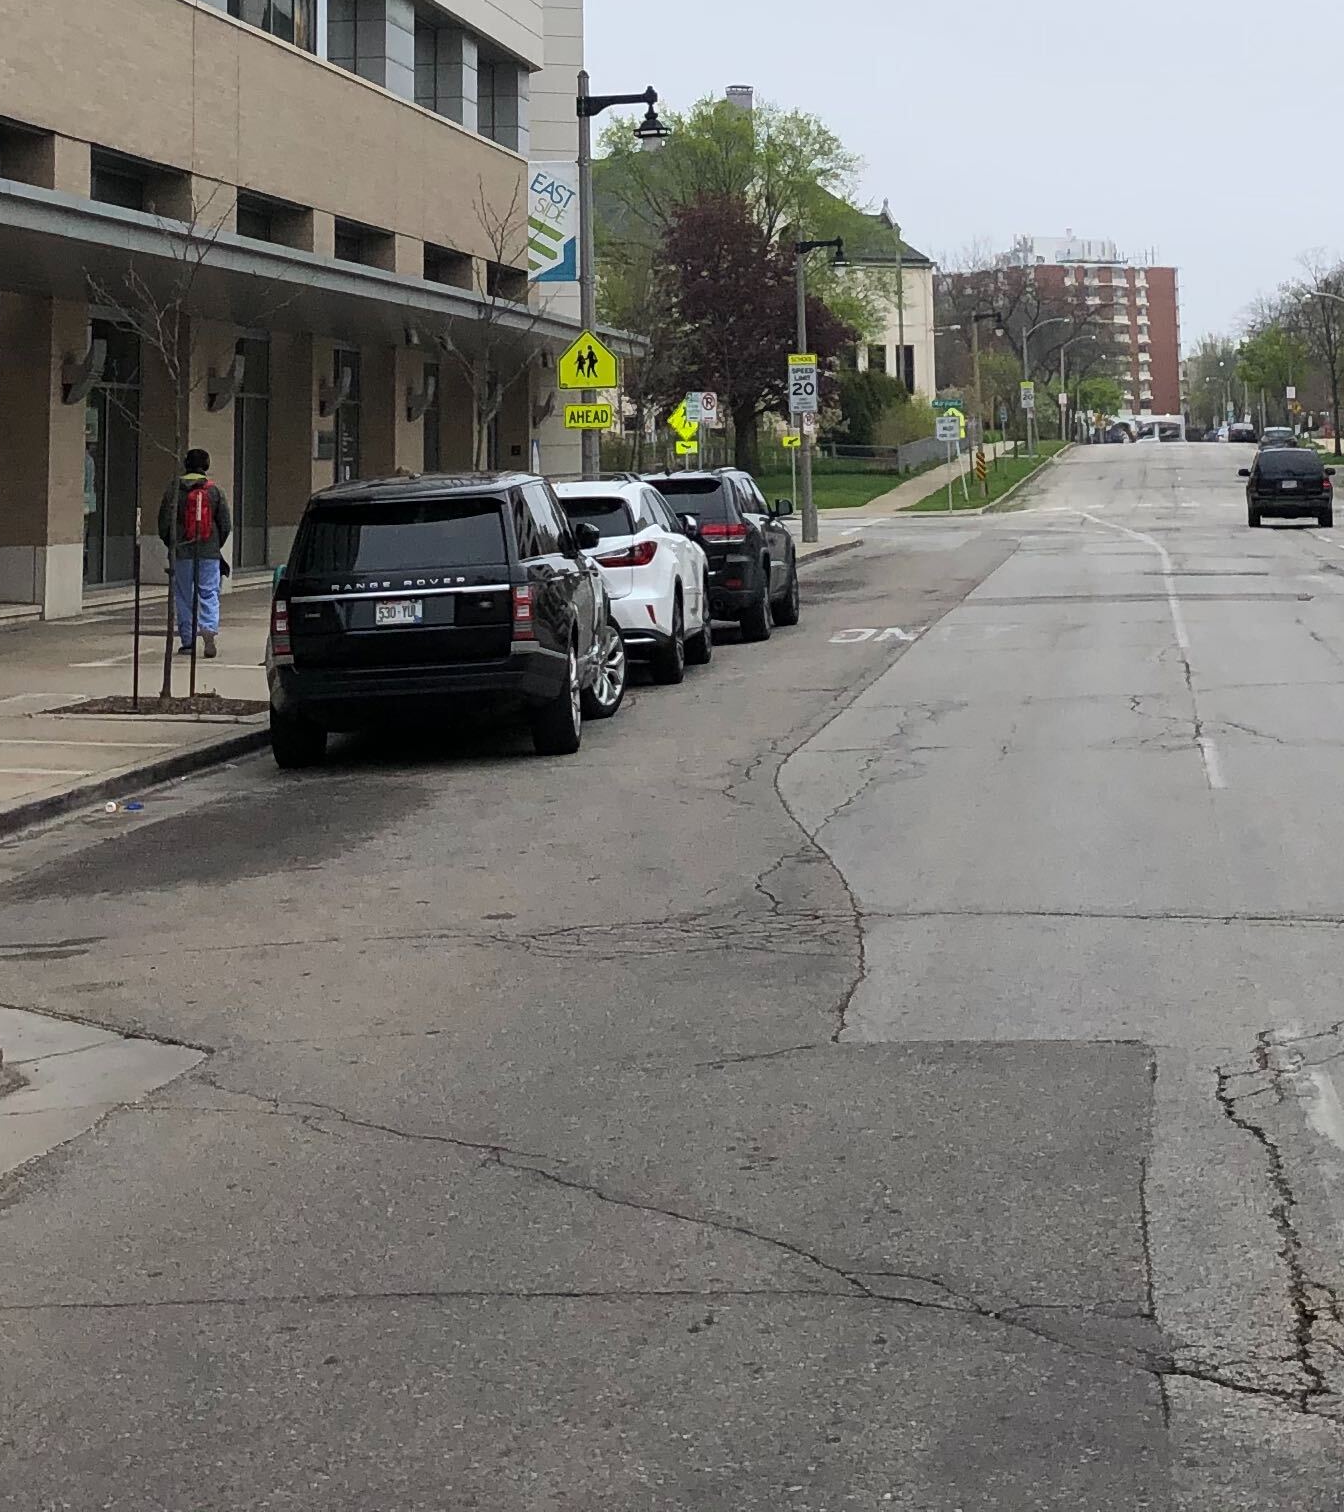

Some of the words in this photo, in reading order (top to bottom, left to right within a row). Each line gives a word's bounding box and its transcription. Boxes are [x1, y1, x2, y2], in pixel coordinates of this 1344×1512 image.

[529, 172, 576, 208] EAST
[534, 197, 568, 225] SIDE
[791, 367, 815, 375] SPEED
[792, 382, 815, 396] 20
[568, 409, 609, 424] AHEAD
[331, 581, 391, 591] RANGE
[403, 576, 466, 587] ROVER
